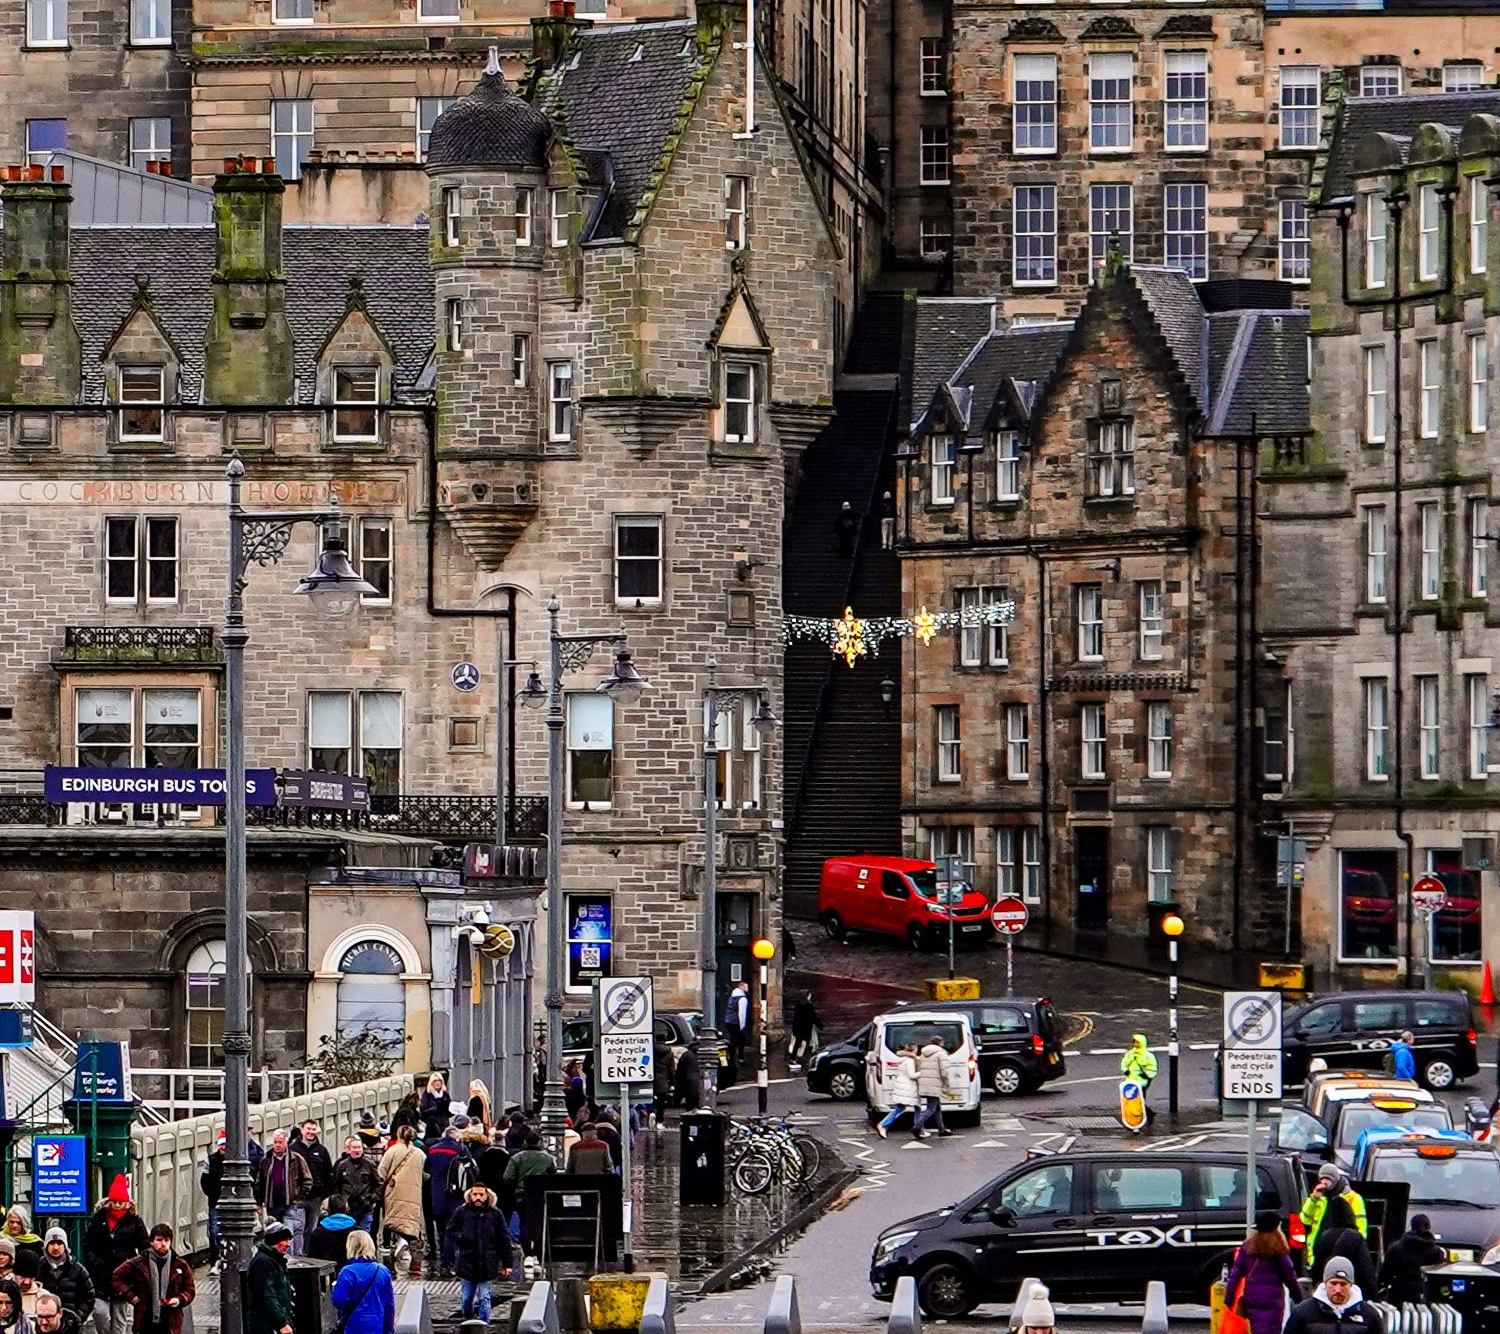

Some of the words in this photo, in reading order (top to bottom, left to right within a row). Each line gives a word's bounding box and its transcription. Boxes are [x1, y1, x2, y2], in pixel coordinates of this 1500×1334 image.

[62, 778, 159, 792] EDINBURGH
[163, 779, 196, 793] BUS
[199, 780, 257, 793] TOUS
[604, 1037, 650, 1045] Pedestrian
[624, 1047, 647, 1055] cycle
[616, 1056, 637, 1064] Zone
[1228, 1052, 1278, 1060] Pedestrian
[1250, 1062, 1274, 1071] cycle
[1241, 1071, 1263, 1079] Zone
[1231, 1082, 1274, 1094] ENDS
[1087, 1226, 1192, 1247] TAXI
